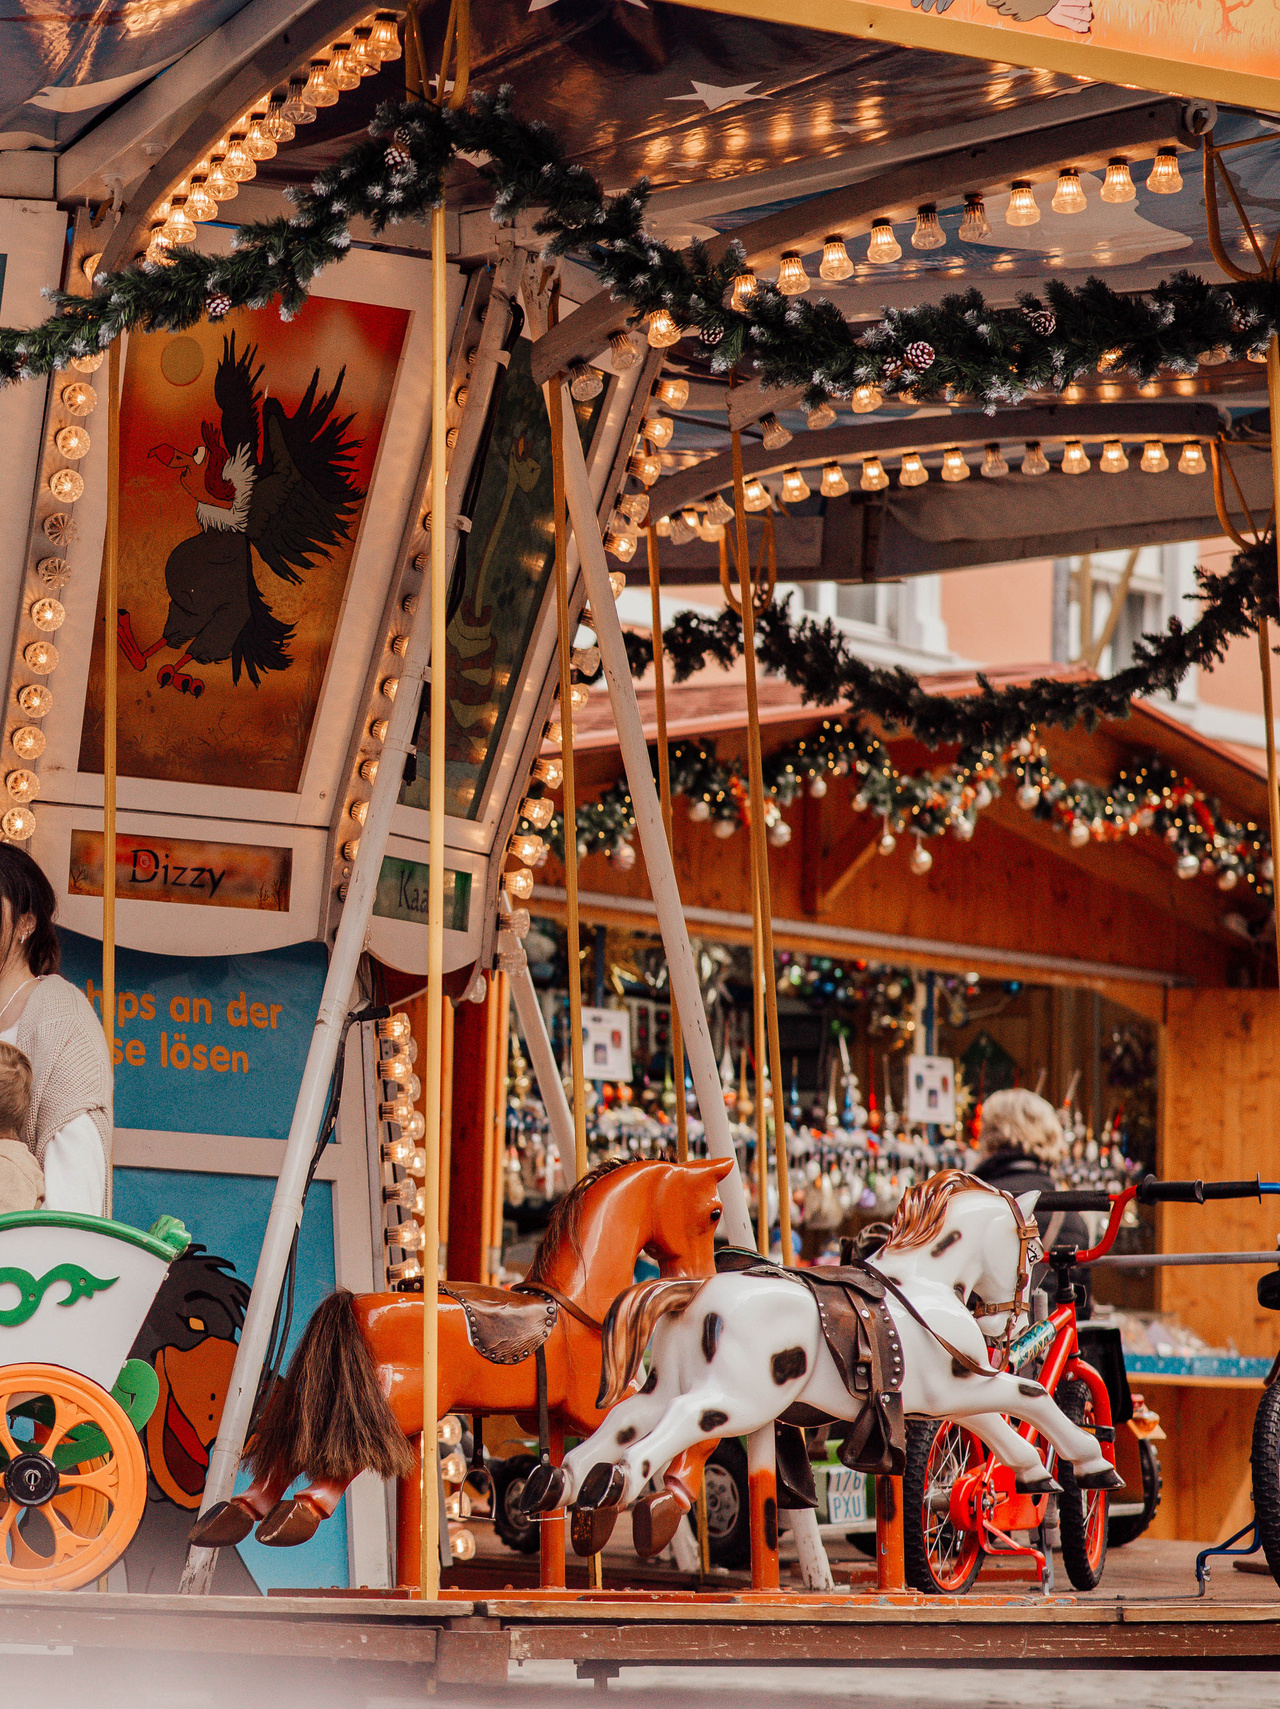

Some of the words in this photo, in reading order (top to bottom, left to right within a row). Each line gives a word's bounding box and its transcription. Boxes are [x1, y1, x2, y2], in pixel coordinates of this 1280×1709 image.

[129, 849, 225, 898] Dizzy
[398, 870, 429, 914] Kaa
[79, 978, 156, 1028] hps
[170, 996, 212, 1025] an
[227, 991, 283, 1030] der
[113, 1037, 146, 1067] se
[160, 1031, 249, 1074] lösen
[835, 1470, 862, 1492] 176
[833, 1495, 862, 1519] PXU
